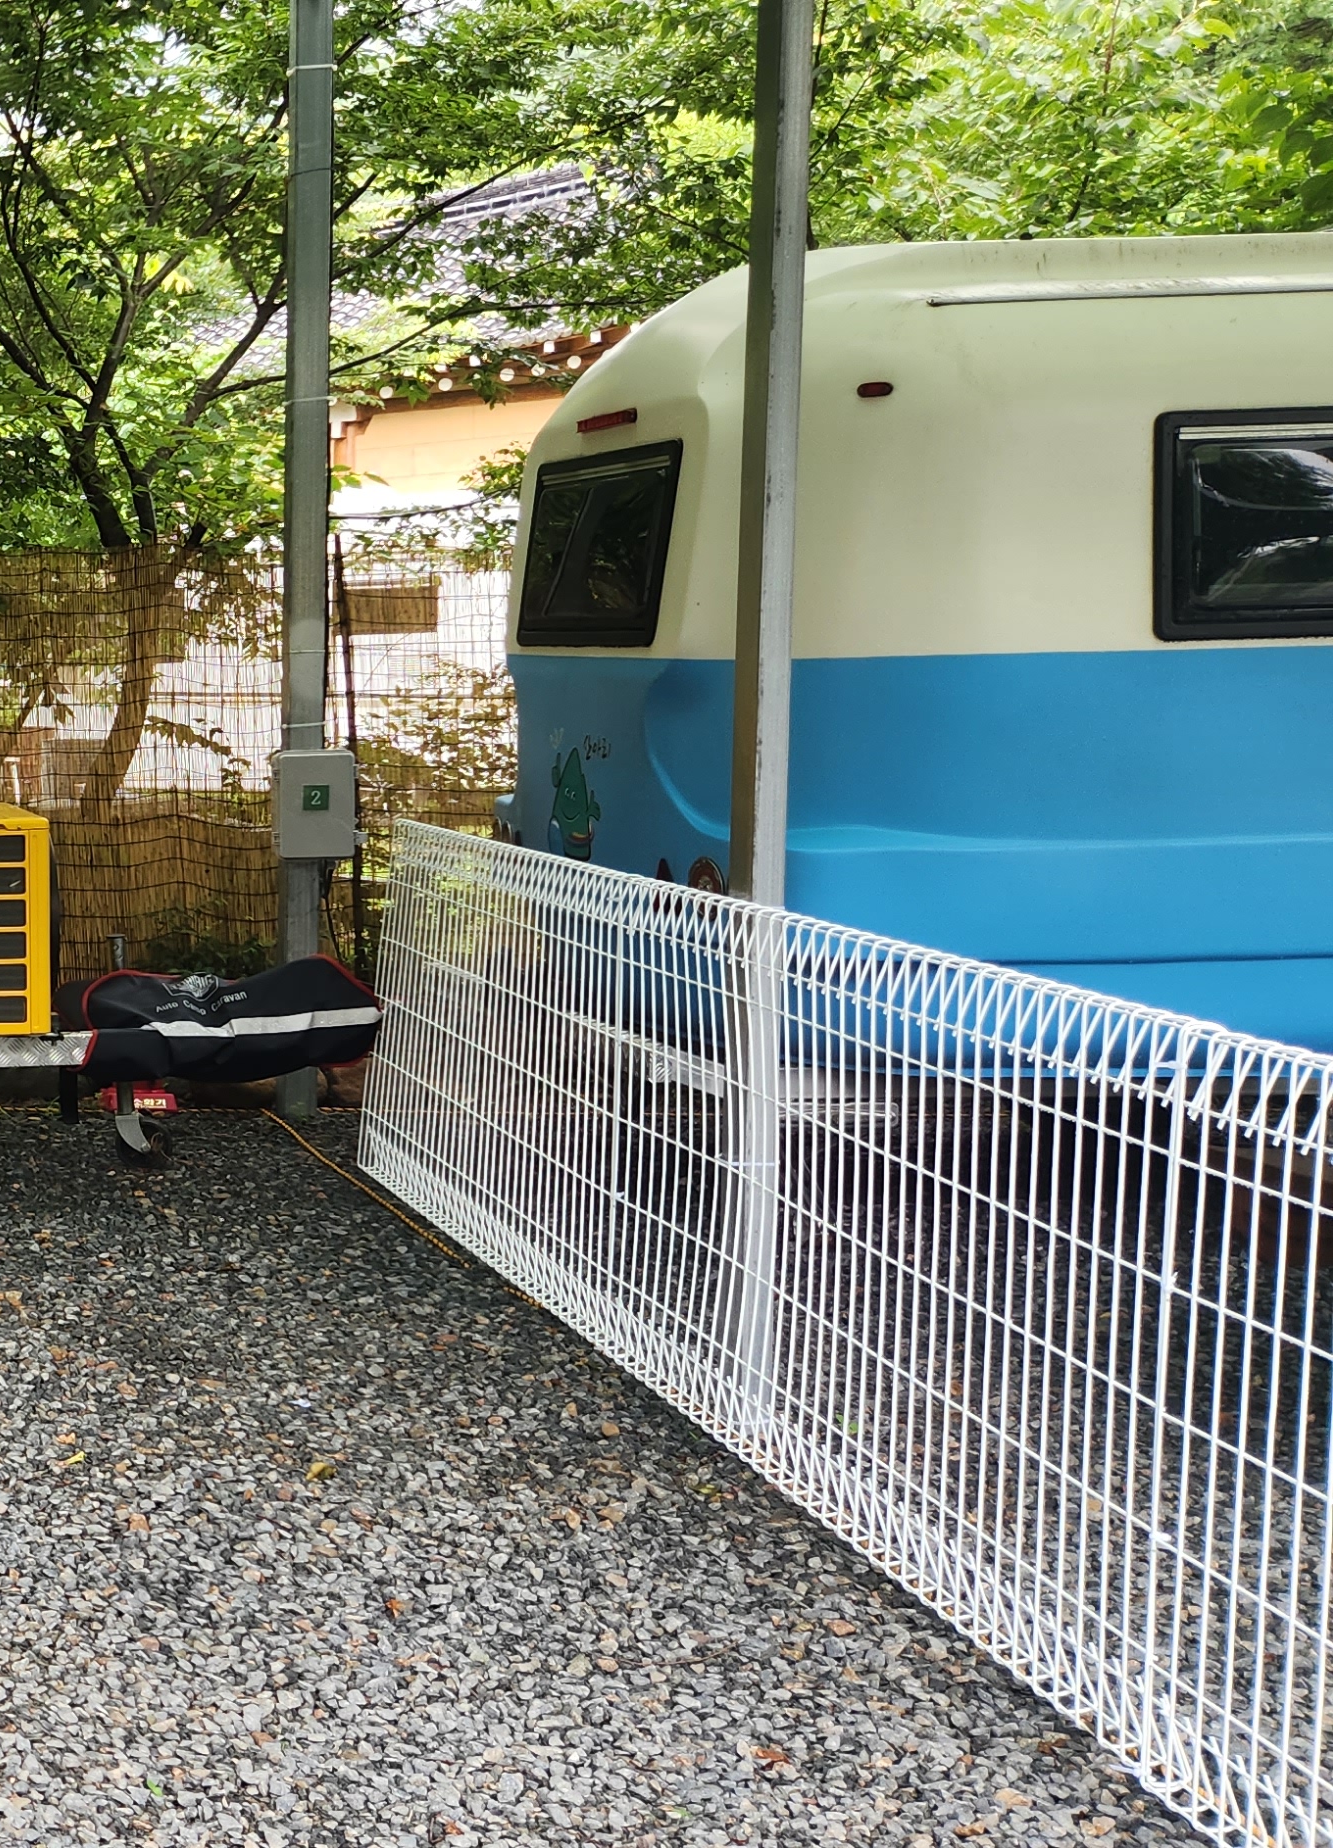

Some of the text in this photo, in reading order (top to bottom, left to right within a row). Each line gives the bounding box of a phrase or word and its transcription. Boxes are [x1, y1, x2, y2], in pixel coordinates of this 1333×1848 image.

[310, 791, 321, 805] 2
[155, 1001, 179, 1013] Auto
[210, 990, 248, 1012] Caravan
[133, 1098, 167, 1109] 소화기
